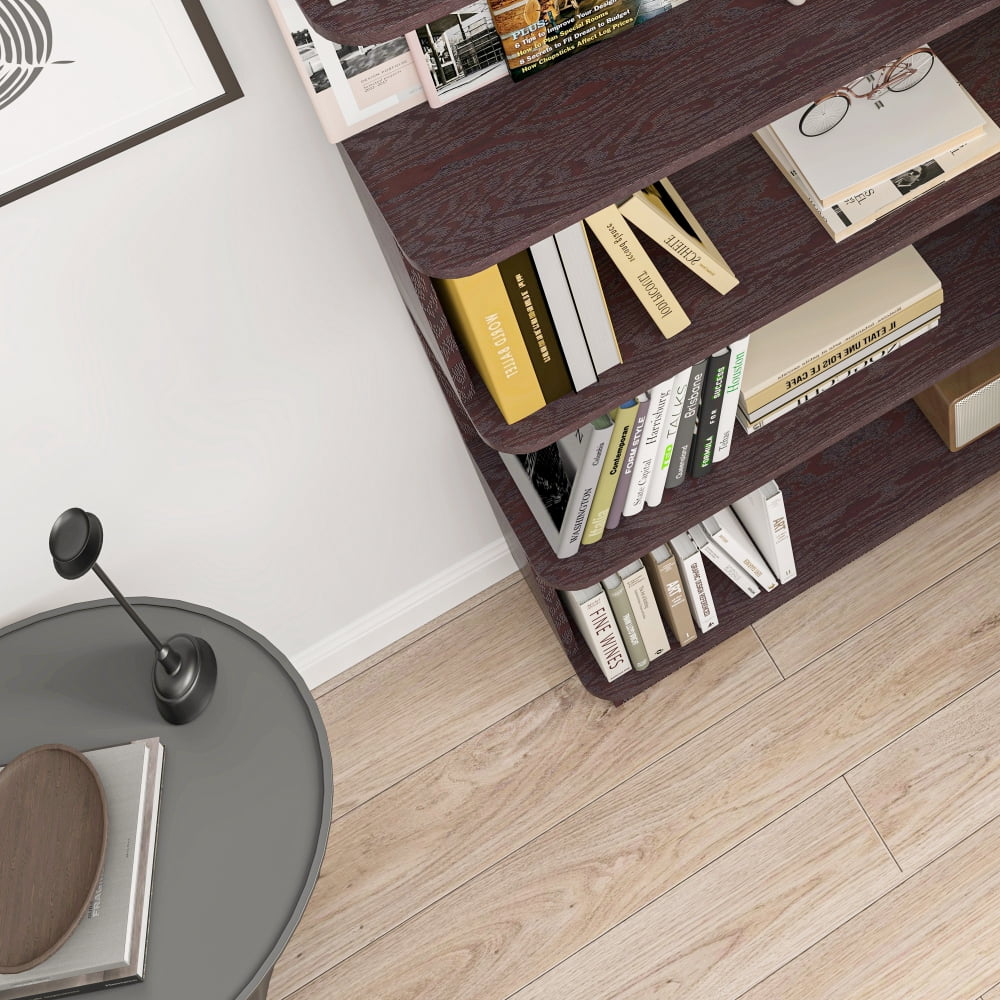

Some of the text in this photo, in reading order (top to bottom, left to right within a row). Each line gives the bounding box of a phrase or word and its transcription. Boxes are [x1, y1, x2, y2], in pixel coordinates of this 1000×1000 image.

[516, 10, 609, 57] How to Plan Special Rooms
[521, 16, 634, 74] How Chopsticks Affect Log Prices
[522, 34, 537, 47] Tips
[538, 31, 546, 39] to
[547, 16, 576, 34] Improve
[577, 8, 593, 20] Your
[526, 46, 554, 62] Secrets
[554, 40, 562, 49] to
[574, 25, 597, 40] Dream
[597, 20, 606, 28] to
[606, 8, 631, 25] Budget
[684, 372, 703, 419] Brisbane
[727, 351, 745, 394] Houston
[645, 389, 672, 446] Harrisburg
[666, 383, 688, 440] TALKS
[701, 366, 726, 468] FORMULA FOR SUCCESS
[624, 415, 646, 475] FORM STYLE
[569, 486, 593, 544] WASHINGTON
[773, 517, 788, 533] ART
[666, 580, 684, 599] ART
[589, 607, 625, 670] FINE WINES
